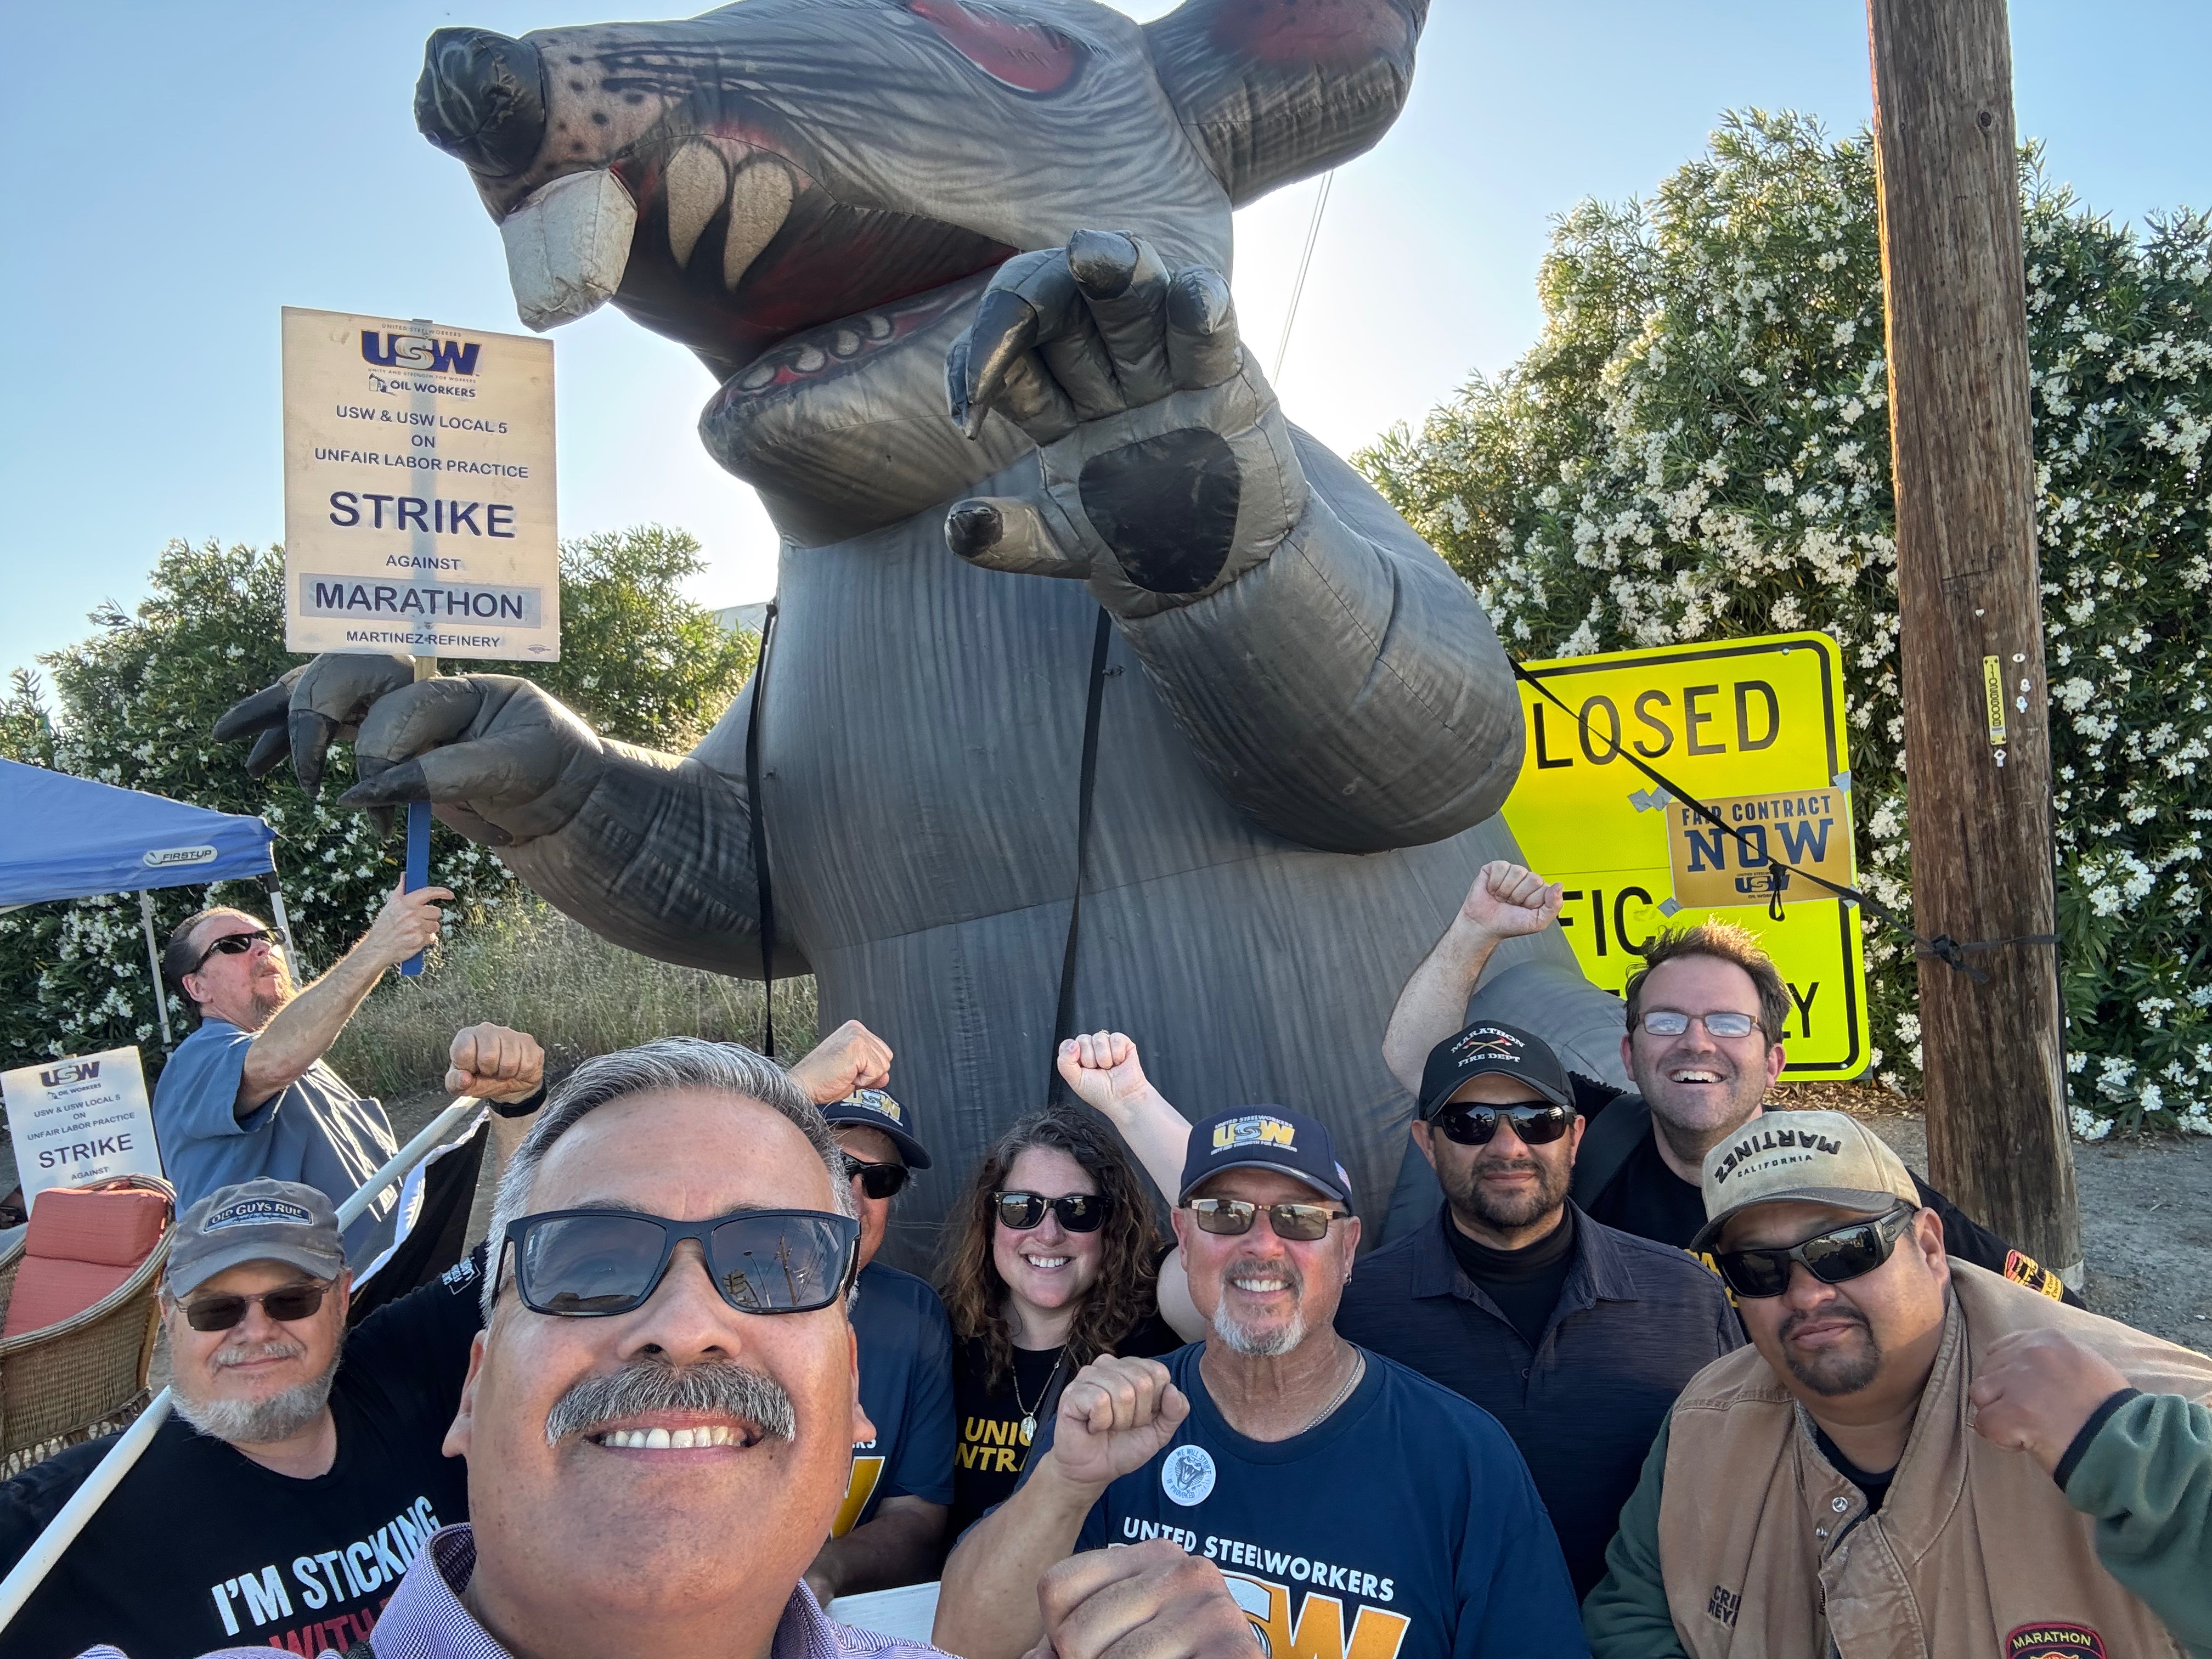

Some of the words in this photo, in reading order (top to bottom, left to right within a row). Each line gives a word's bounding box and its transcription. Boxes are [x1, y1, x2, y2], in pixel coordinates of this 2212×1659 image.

[361, 329, 482, 376] USW
[390, 380, 411, 390] OIL
[414, 382, 476, 398] WORKERS
[336, 405, 375, 420] USW
[380, 410, 392, 423] &
[397, 411, 435, 427] USW
[439, 415, 495, 433] LOCAL
[498, 422, 508, 434] 5
[411, 435, 435, 448] ON
[314, 447, 380, 465] UNFAIR
[384, 454, 442, 471] LABOR
[447, 459, 529, 478] PRACTICE
[329, 491, 516, 538] STRIKE
[386, 554, 461, 571] AGAINST
[315, 582, 523, 619] MARATHON
[346, 630, 424, 645] MARTINEZ
[428, 634, 501, 648] REFINERY
[1532, 680, 1780, 770] LOSED
[1732, 795, 1831, 822] CONTRACT
[1684, 817, 1834, 872] NOW
[1450, 1027, 1526, 1054] MARATHON
[1457, 1053, 1485, 1068] FIRE
[1487, 1052, 1521, 1063] DEPT
[40, 1061, 100, 1087] USW
[70, 1083, 101, 1093] WORKERS
[33, 1108, 54, 1118] USW
[64, 1102, 83, 1112] USW
[85, 1096, 114, 1107] LOCAL
[27, 1128, 60, 1141] UNFAIR
[61, 1122, 91, 1133] LABOR
[93, 1112, 136, 1126] PRACTICE
[1213, 1120, 1295, 1148] USW
[1215, 1118, 1238, 1129] UNITED
[1239, 1115, 1293, 1128] STEELWORKERS
[38, 1133, 133, 1168] STRIKE
[1714, 1130, 1842, 1184] MARTINEZ
[71, 1166, 109, 1181] AGAINST
[1737, 1154, 1813, 1178] CALIFORNIA
[212, 1210, 234, 1223] OLD
[236, 1202, 272, 1215] GUYS
[954, 1442, 1029, 1472] NTR
[1187, 1448, 1199, 1457] WILL
[1199, 1454, 1212, 1474] STRIKE
[292, 1496, 441, 1610] STICKING
[1203, 1536, 1395, 1602] STEELWORKERS
[2012, 1631, 2091, 1649] MARATHON
